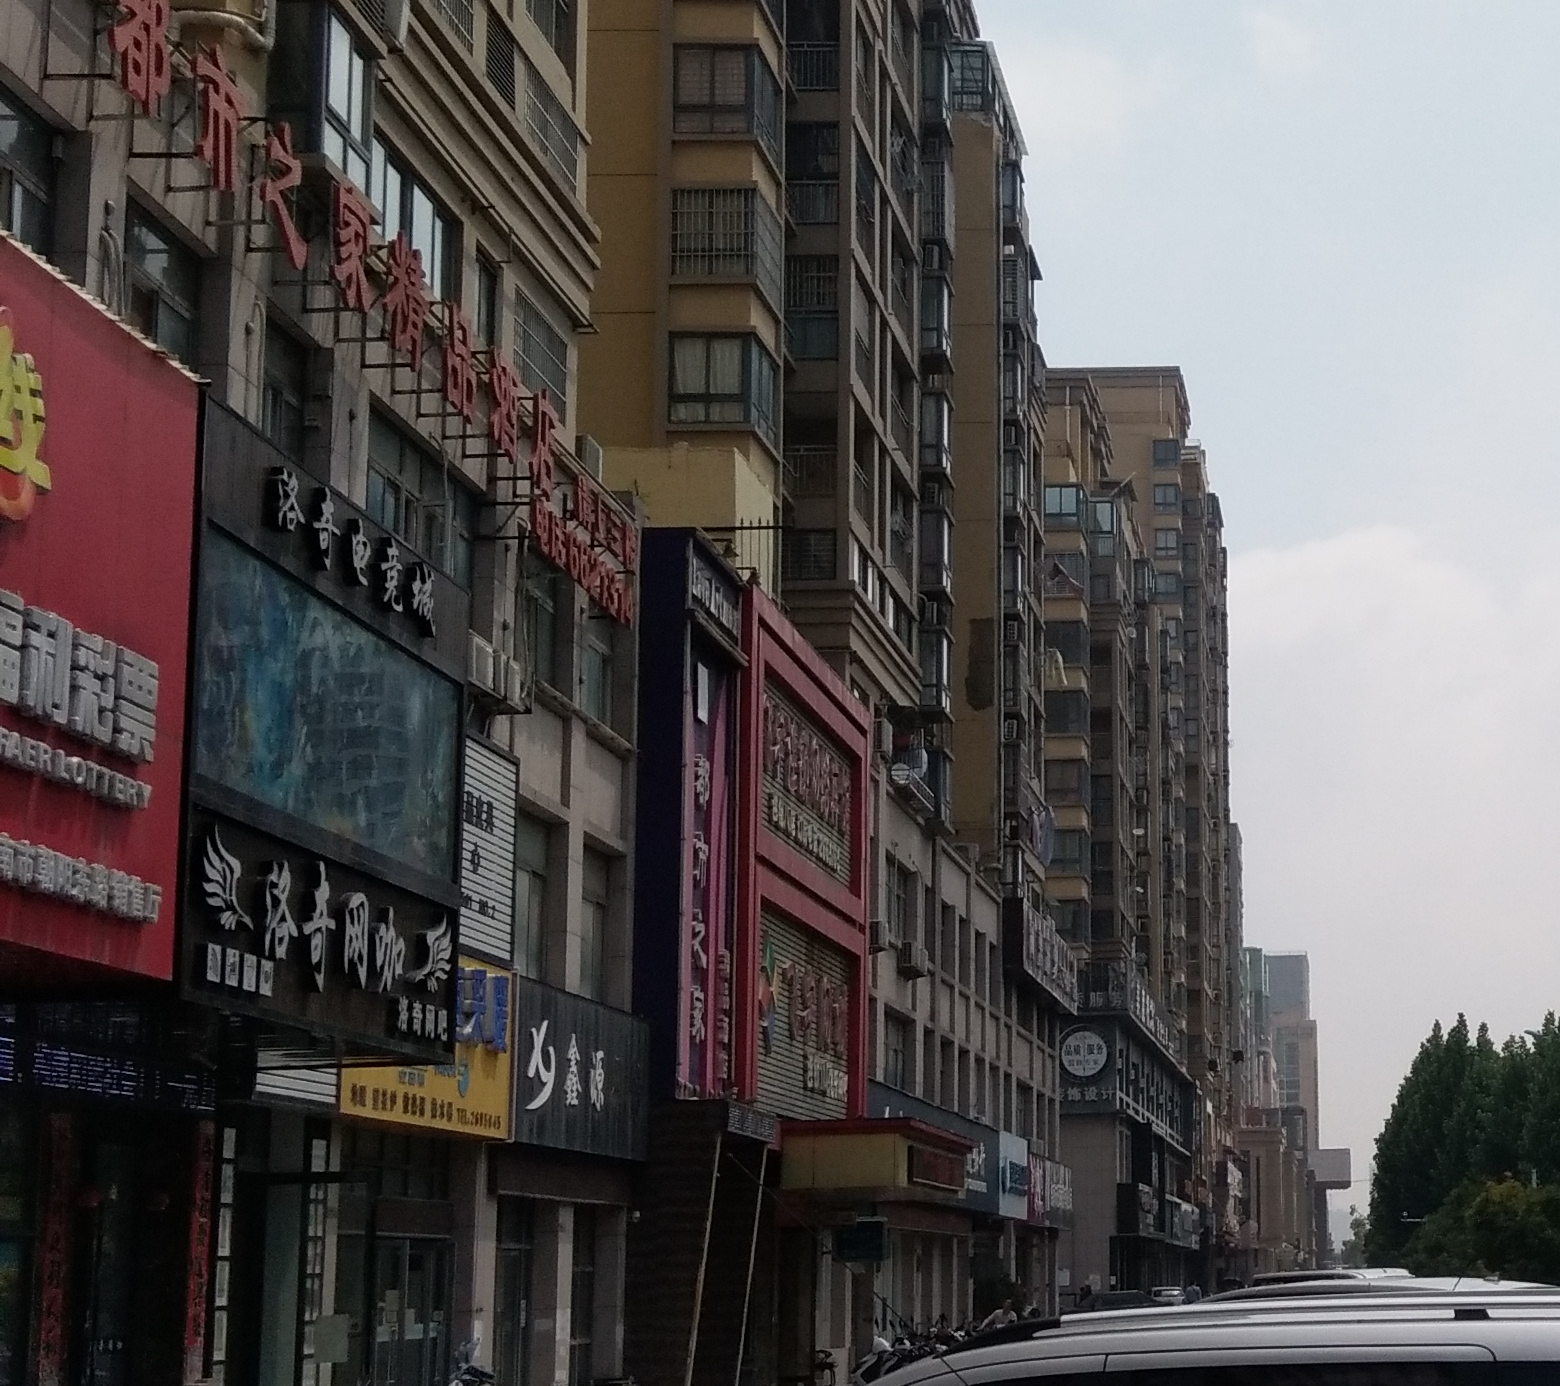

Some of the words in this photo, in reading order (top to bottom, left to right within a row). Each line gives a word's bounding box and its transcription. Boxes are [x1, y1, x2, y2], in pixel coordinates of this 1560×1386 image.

[264, 859, 405, 993] 洛奇网咖
[690, 753, 711, 1045] 都市之家
[398, 995, 448, 1042] 洛奇网吧
